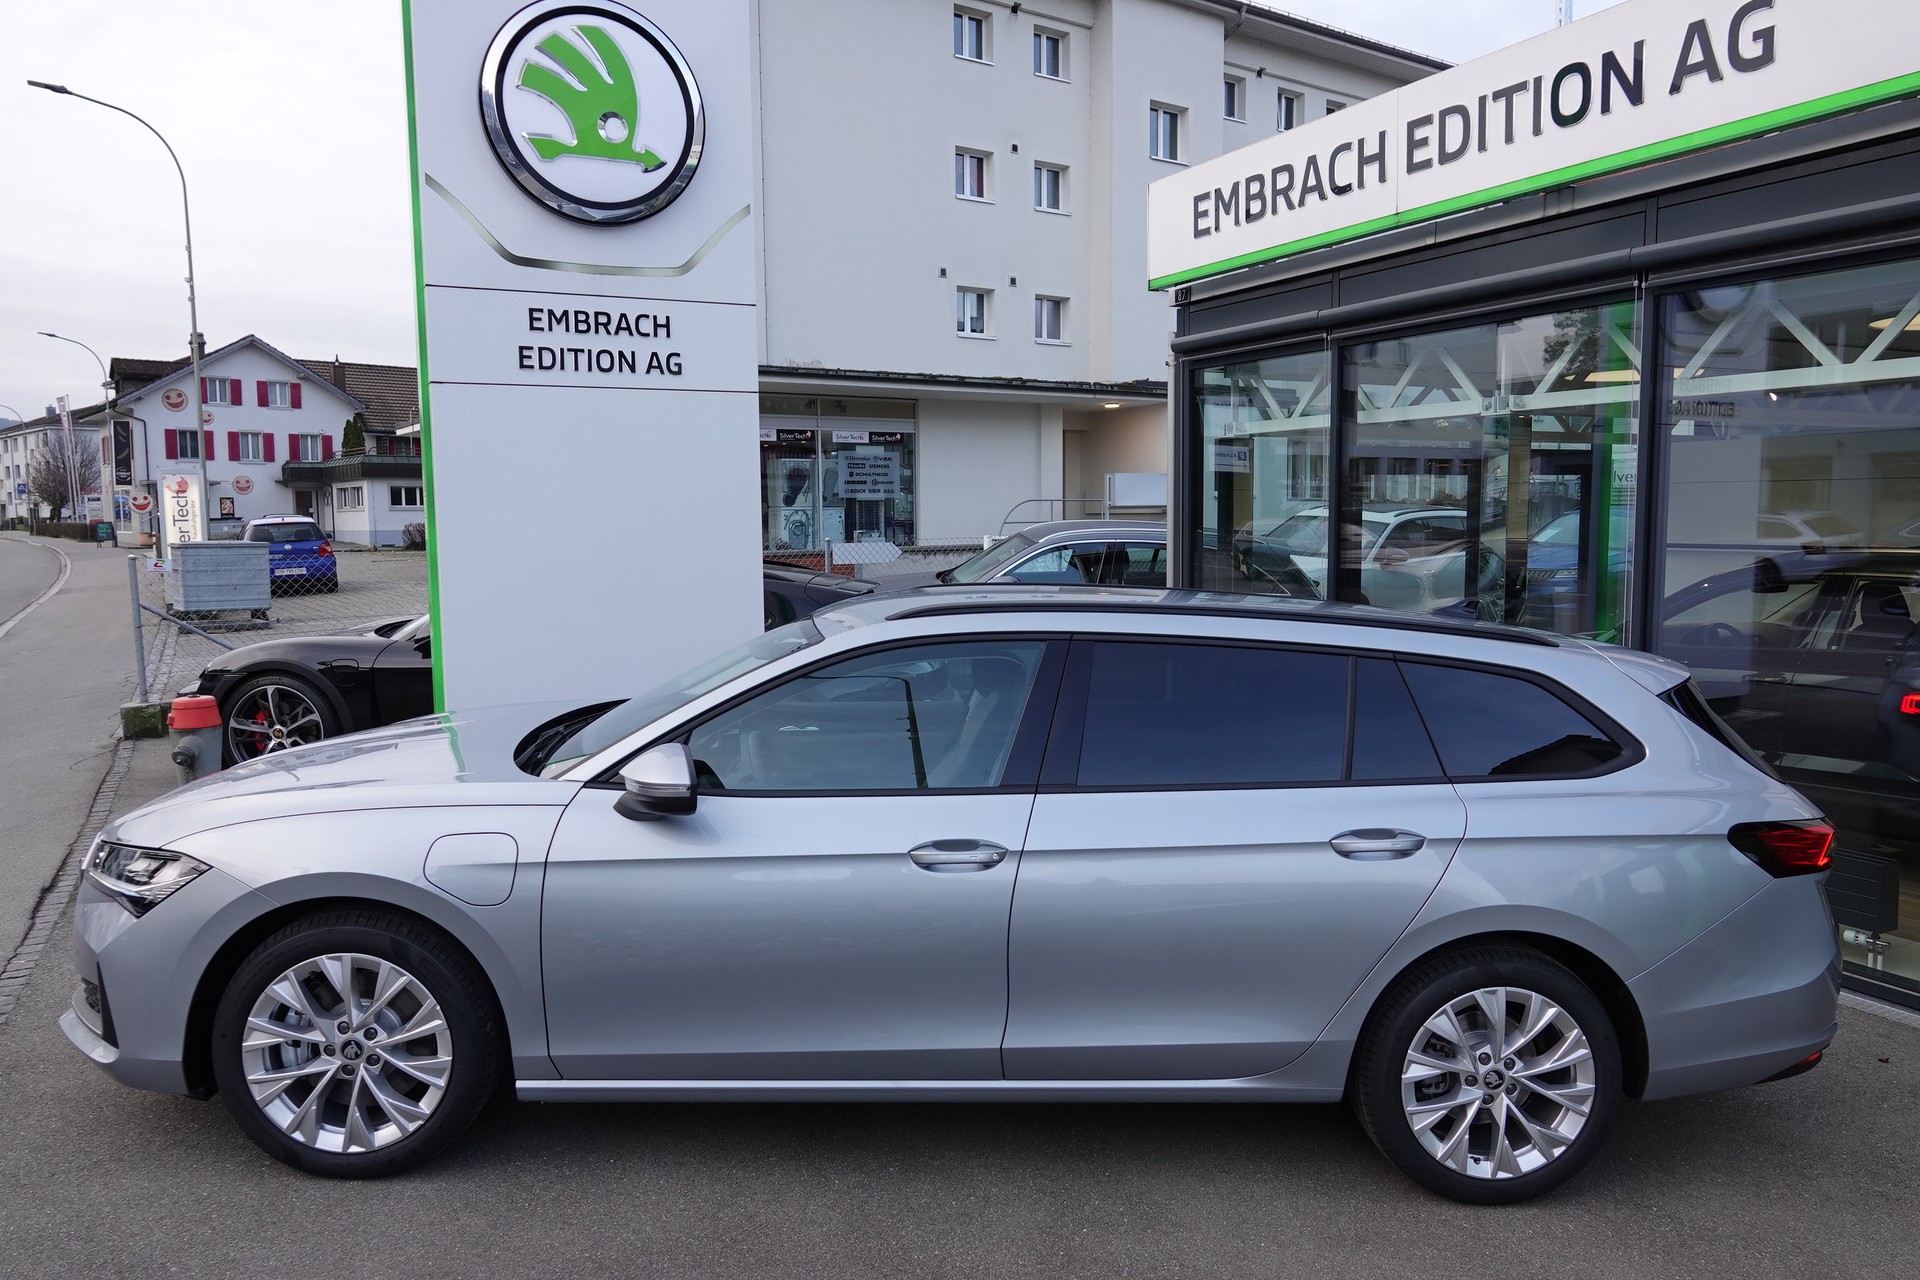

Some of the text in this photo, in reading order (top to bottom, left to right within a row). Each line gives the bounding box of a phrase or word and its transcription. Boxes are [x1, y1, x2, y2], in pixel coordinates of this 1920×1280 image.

[1193, 0, 1776, 240] EMBRACH EDITION AG
[528, 307, 671, 338] EMBRACH
[518, 345, 683, 376] EDITION AG
